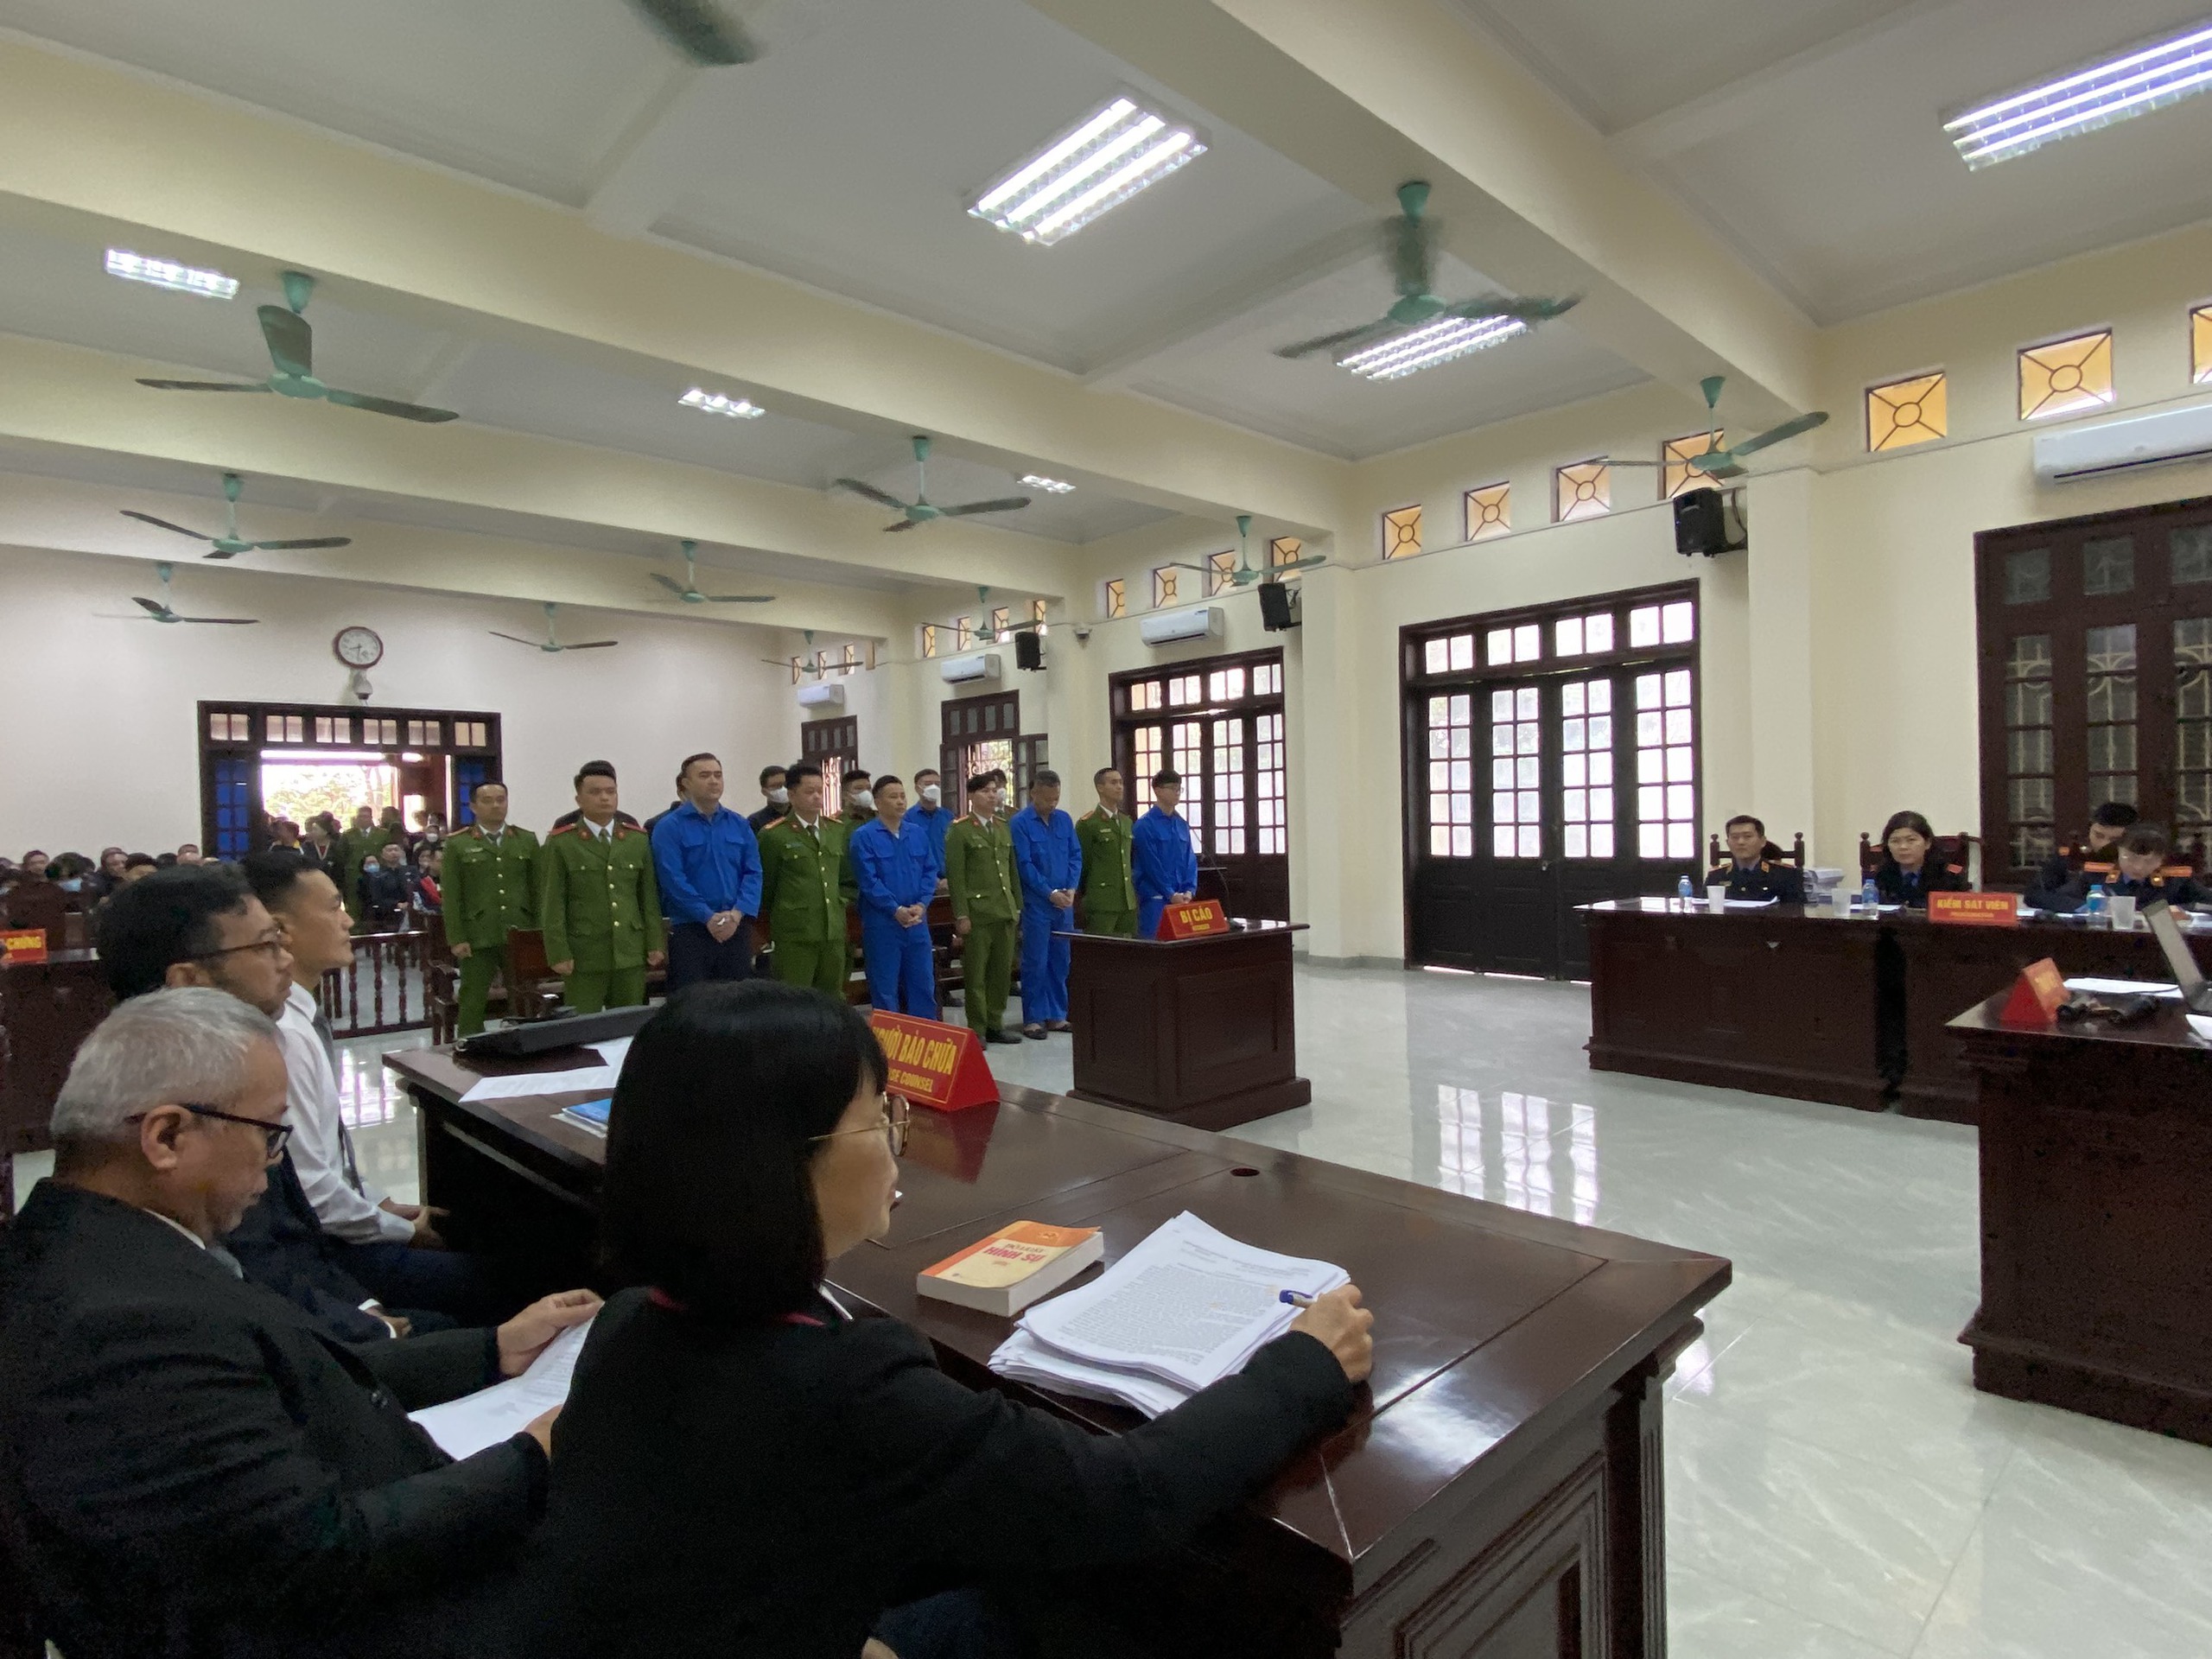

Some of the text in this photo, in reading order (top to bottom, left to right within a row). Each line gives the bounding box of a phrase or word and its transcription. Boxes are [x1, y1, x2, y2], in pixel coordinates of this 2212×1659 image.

[1179, 906, 1212, 925] BỊ CÁO
[923, 1037, 957, 1075] CHỮA
